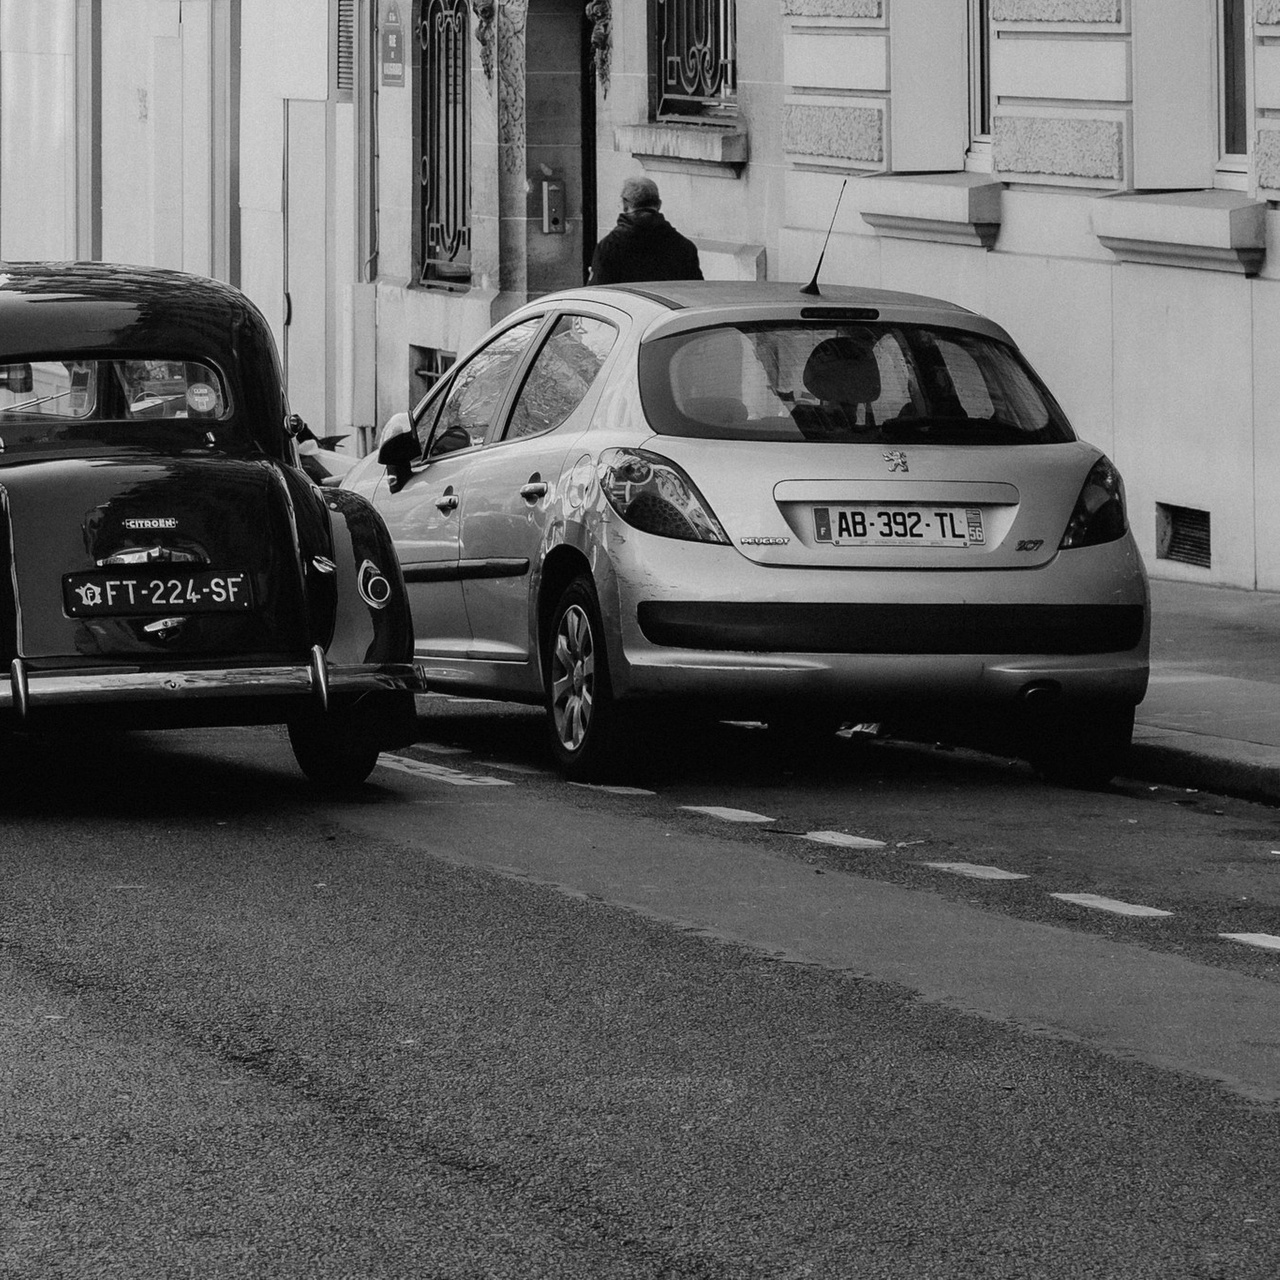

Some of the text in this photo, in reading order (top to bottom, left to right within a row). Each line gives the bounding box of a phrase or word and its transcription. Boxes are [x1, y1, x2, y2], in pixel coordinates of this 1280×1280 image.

[838, 512, 966, 538] AB-392-TL
[969, 527, 983, 540] 56
[740, 537, 790, 546] PEUGEOT
[1015, 540, 1044, 551] 207
[106, 578, 242, 605] FT-224-SF
